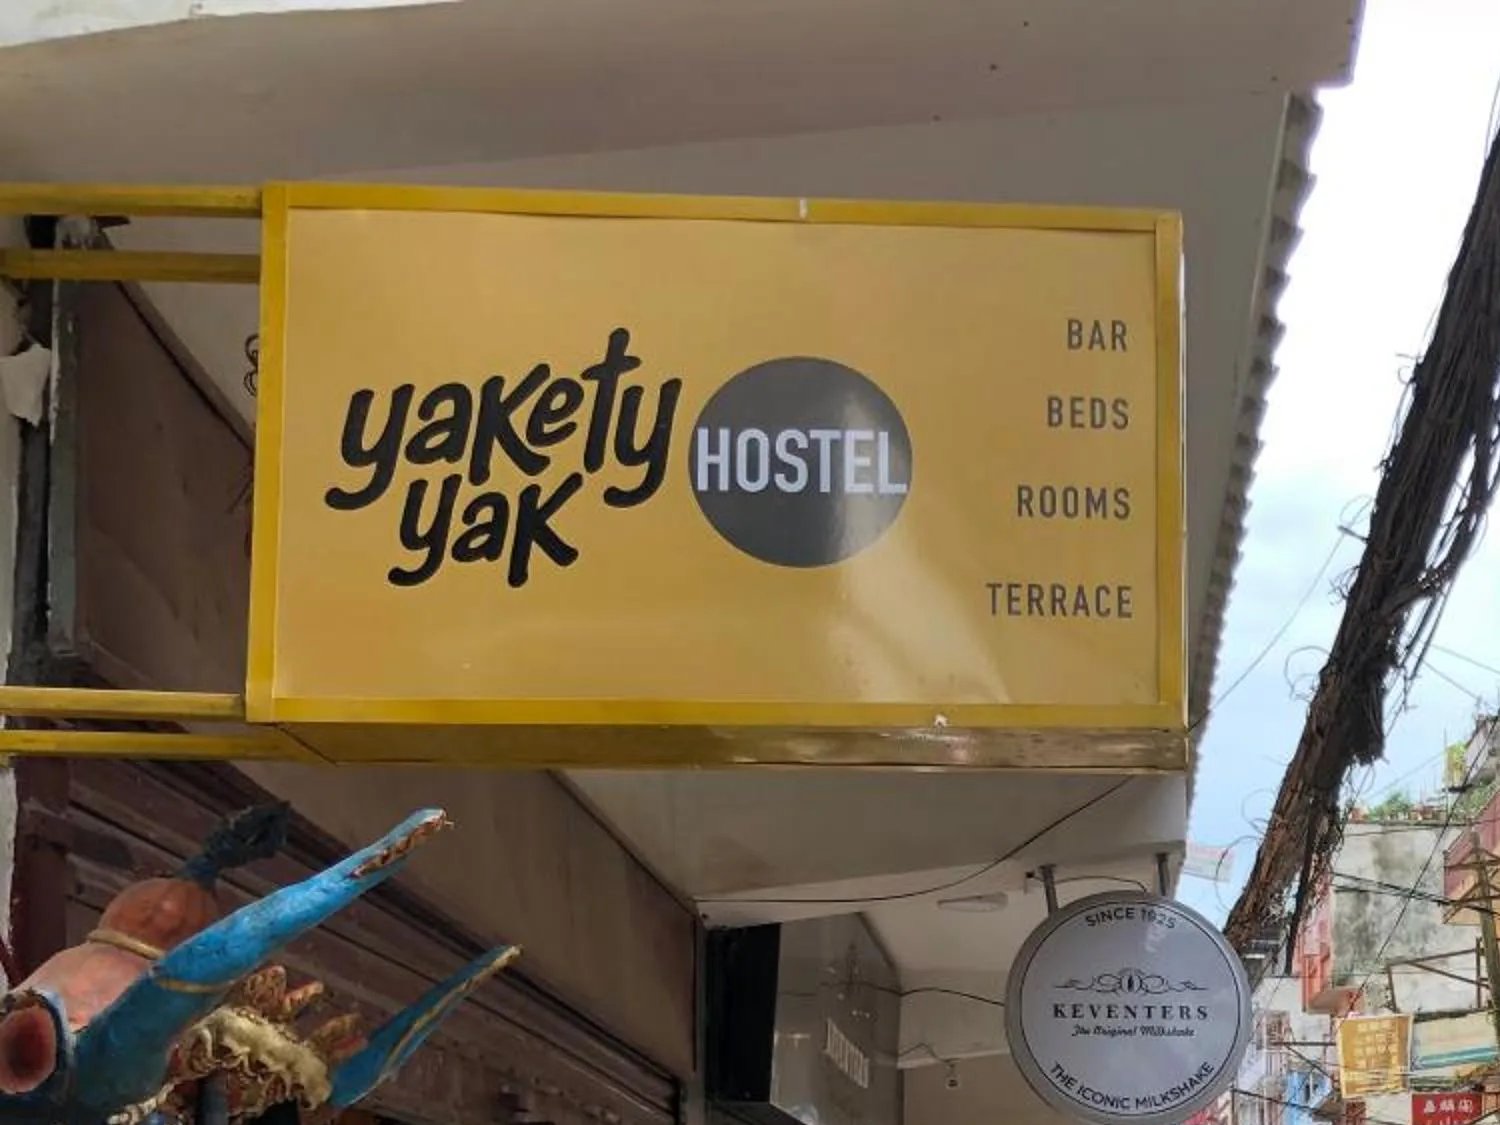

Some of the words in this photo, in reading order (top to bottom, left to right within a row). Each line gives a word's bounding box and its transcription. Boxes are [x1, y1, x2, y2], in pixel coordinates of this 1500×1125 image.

[1067, 320, 1128, 352] BAR
[1046, 397, 1129, 431] BEDS
[695, 427, 907, 496] HOSTEL
[1016, 485, 1131, 521] ROOMS
[388, 472, 583, 588] yak
[986, 582, 1132, 618] TERRACE
[1085, 907, 1136, 927] SINCE
[1053, 1003, 1209, 1021] KEVENTERS
[1050, 1061, 1077, 1093] THE
[1077, 1084, 1131, 1110] ICONIC
[1135, 1061, 1215, 1110] MILKSHAKE
